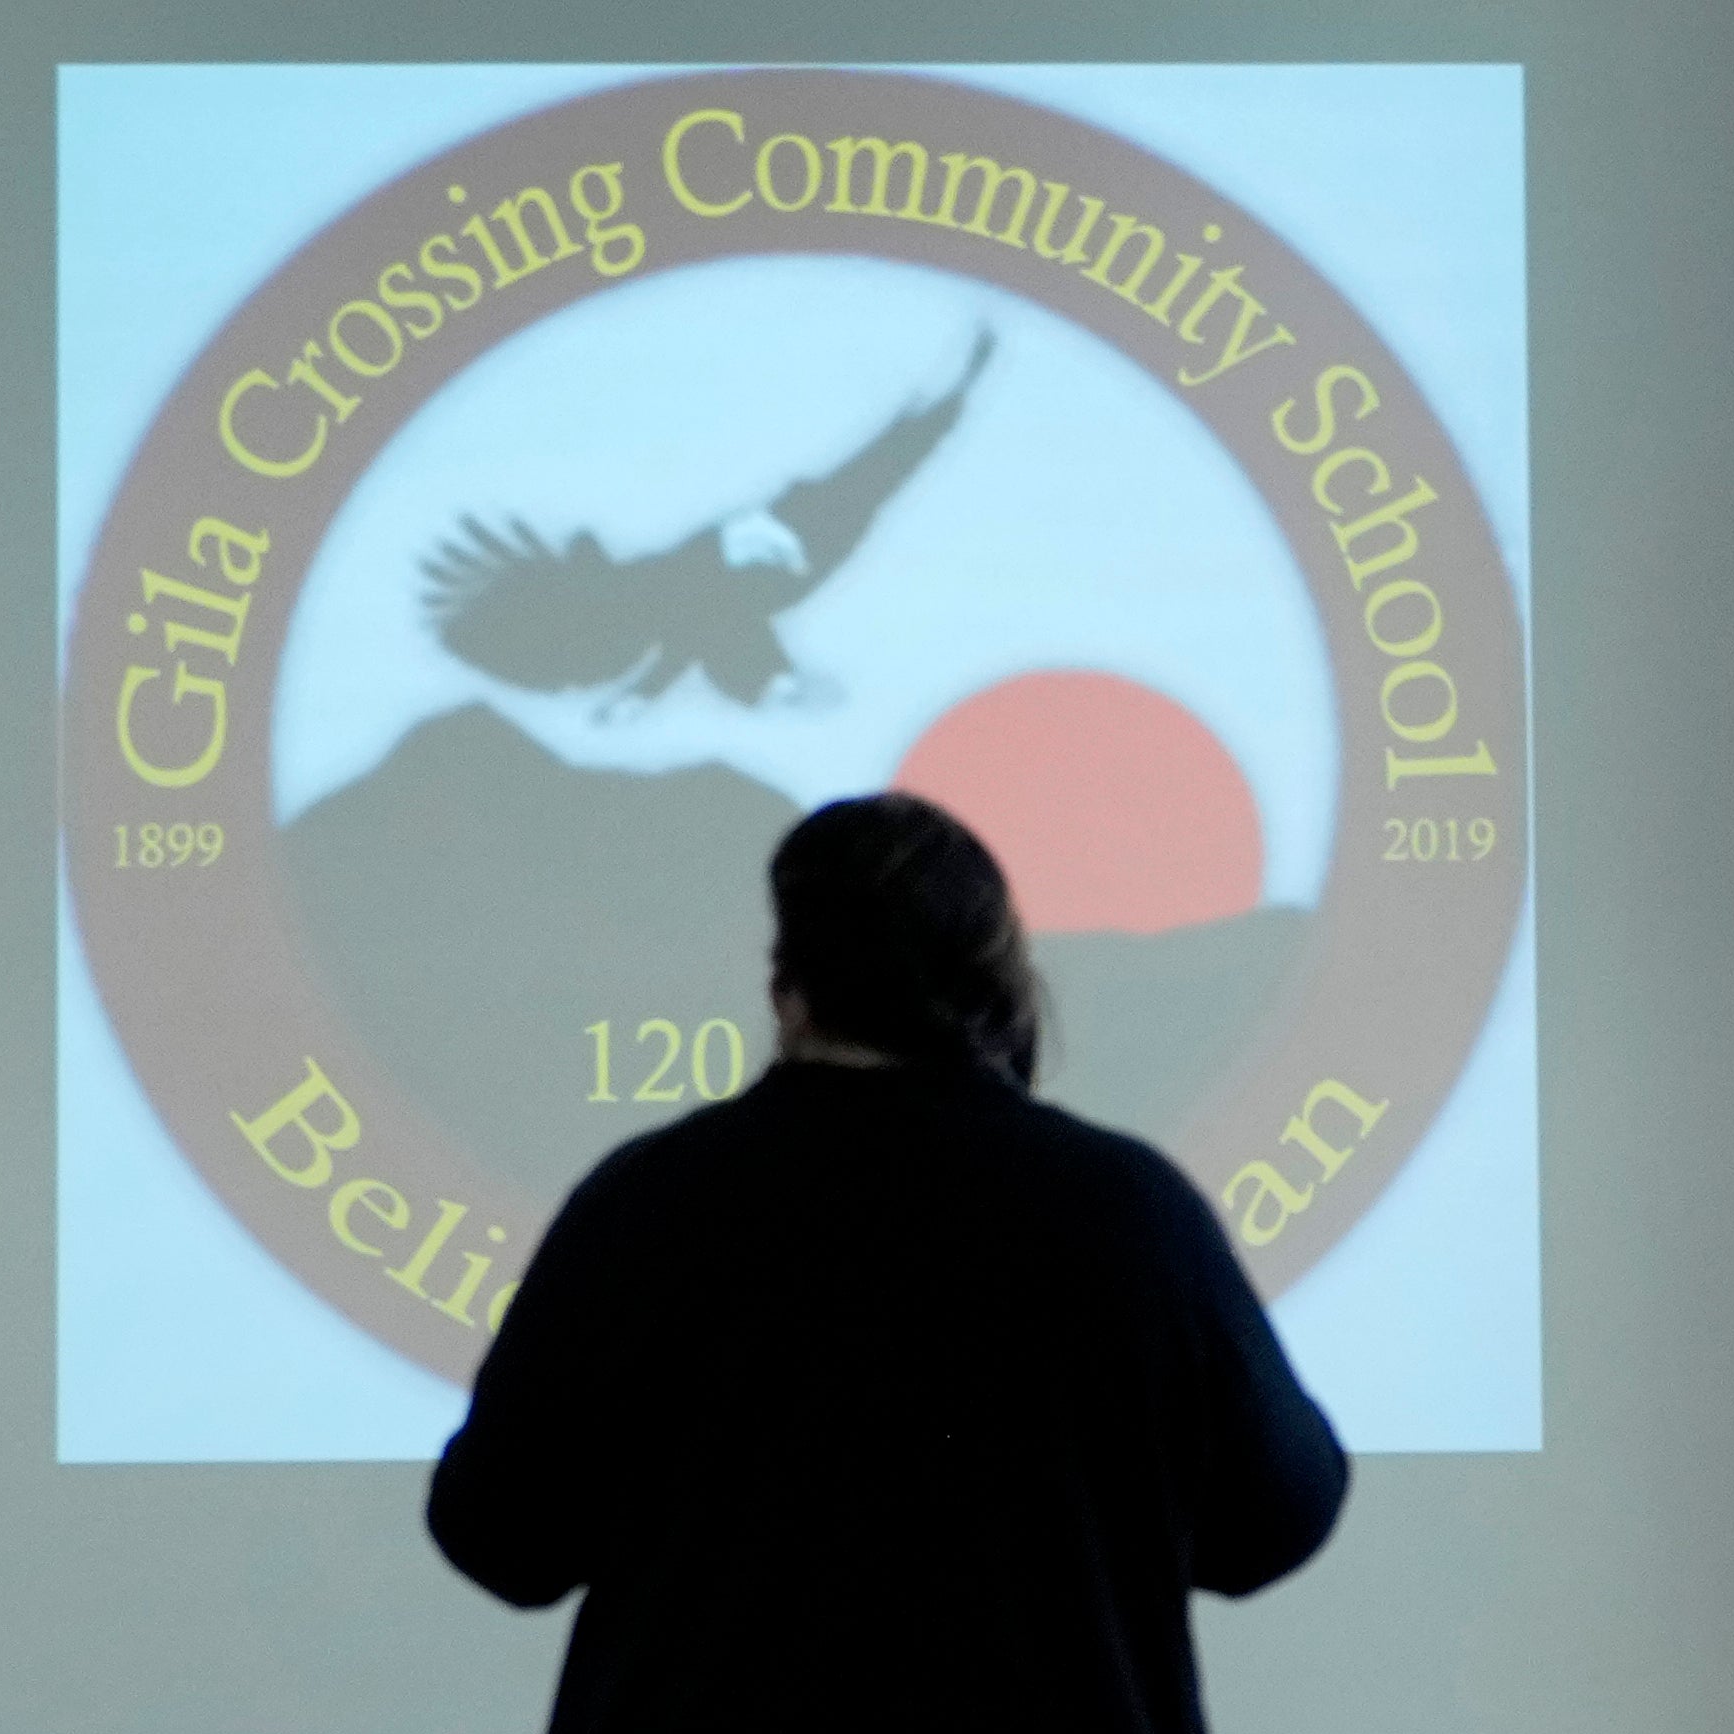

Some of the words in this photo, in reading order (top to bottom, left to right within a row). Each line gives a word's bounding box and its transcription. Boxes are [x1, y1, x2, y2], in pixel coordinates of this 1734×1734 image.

[116, 515, 271, 789] Gila
[218, 161, 647, 479] Crossing
[662, 108, 1297, 387] Community
[1271, 363, 1499, 792] School
[113, 821, 225, 870] 1899
[1381, 817, 1497, 863] 2019
[583, 1017, 746, 1102] 120
[1221, 1078, 1391, 1247] an
